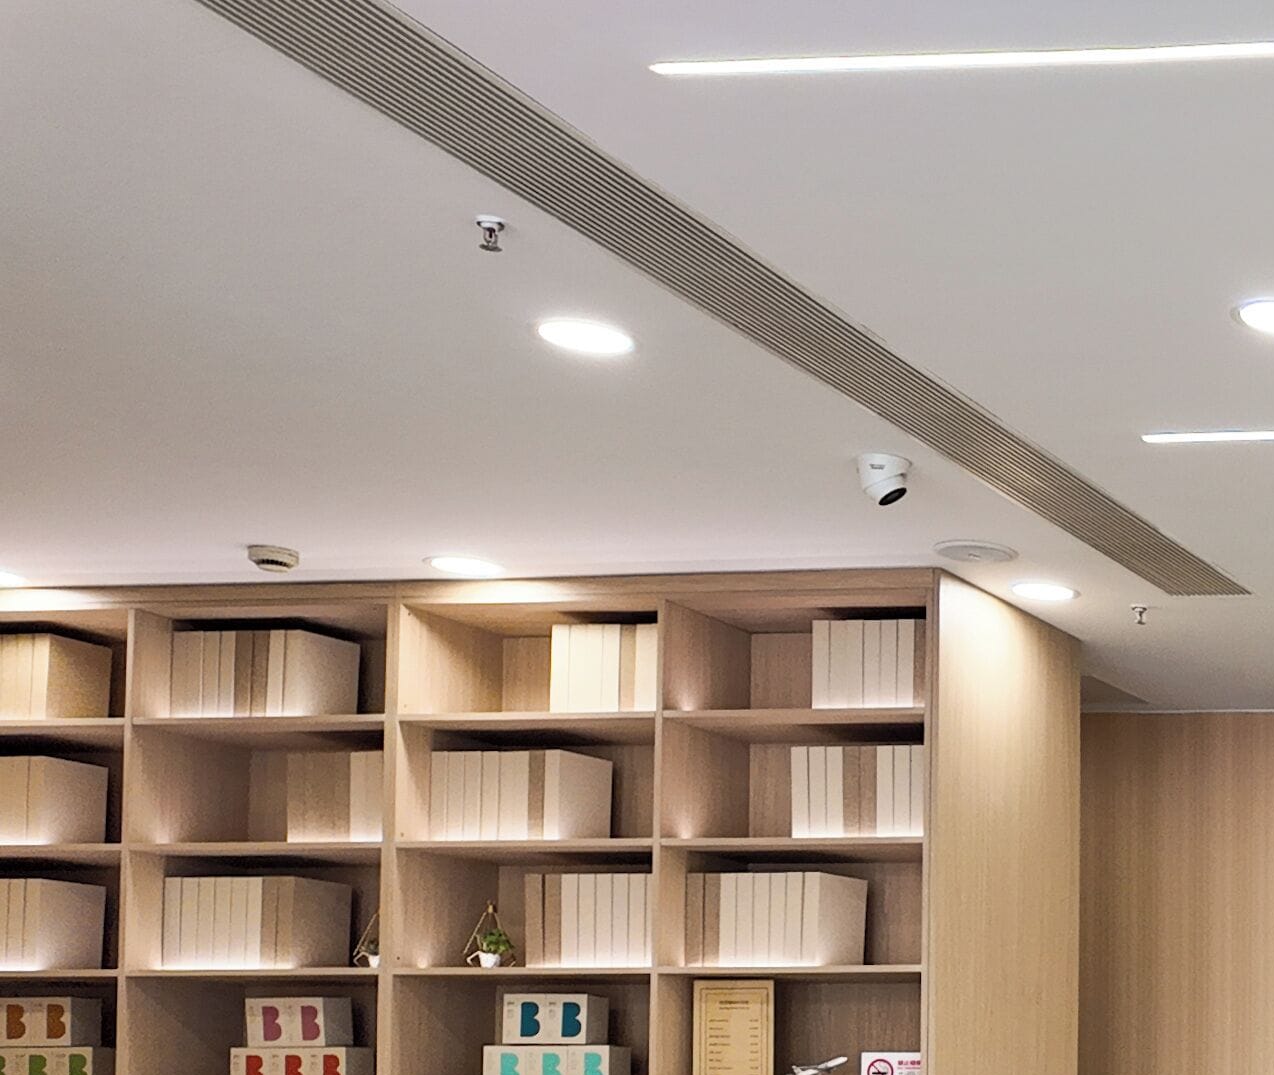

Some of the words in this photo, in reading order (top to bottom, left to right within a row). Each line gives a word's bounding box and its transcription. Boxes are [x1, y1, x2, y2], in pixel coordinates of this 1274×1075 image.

[6, 1004, 26, 1039] B
[46, 1004, 66, 1039] B
[261, 1006, 282, 1041] B
[301, 1005, 321, 1040] B
[520, 1001, 540, 1037] B
[561, 1002, 582, 1037] B
